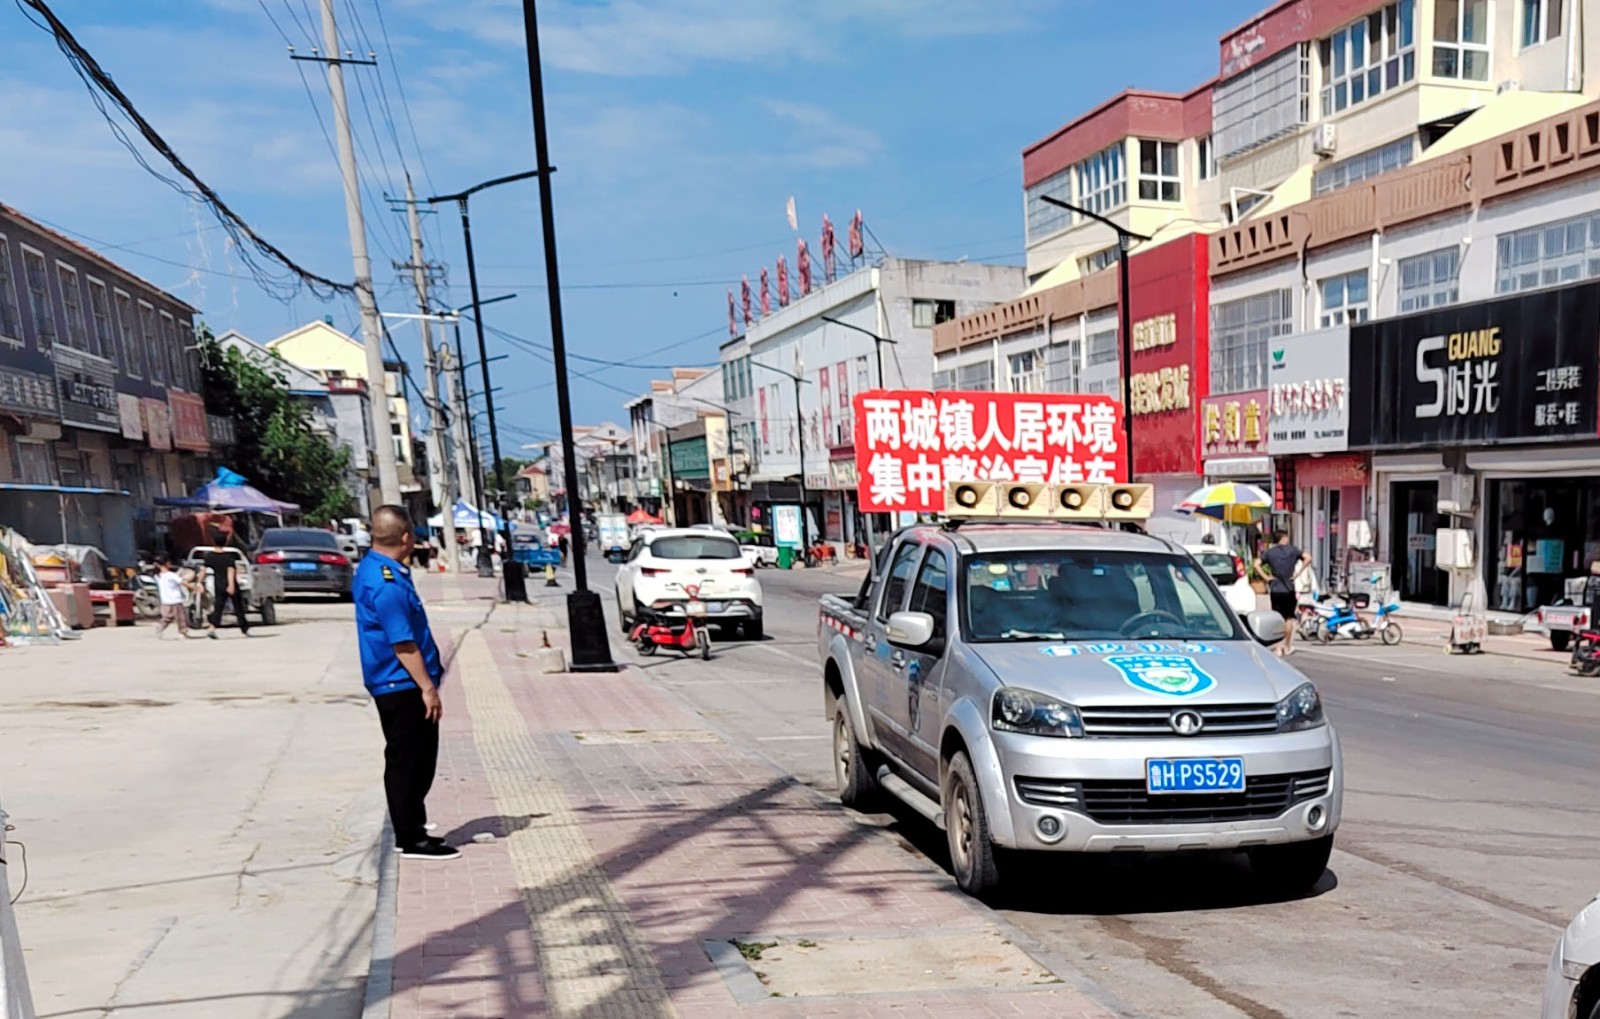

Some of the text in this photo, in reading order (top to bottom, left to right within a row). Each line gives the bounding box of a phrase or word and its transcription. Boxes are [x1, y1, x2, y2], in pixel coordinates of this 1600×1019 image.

[1448, 327, 1502, 361] GUANG
[1447, 360, 1500, 416] 时光
[863, 398, 1118, 454] 两城镇人居环境
